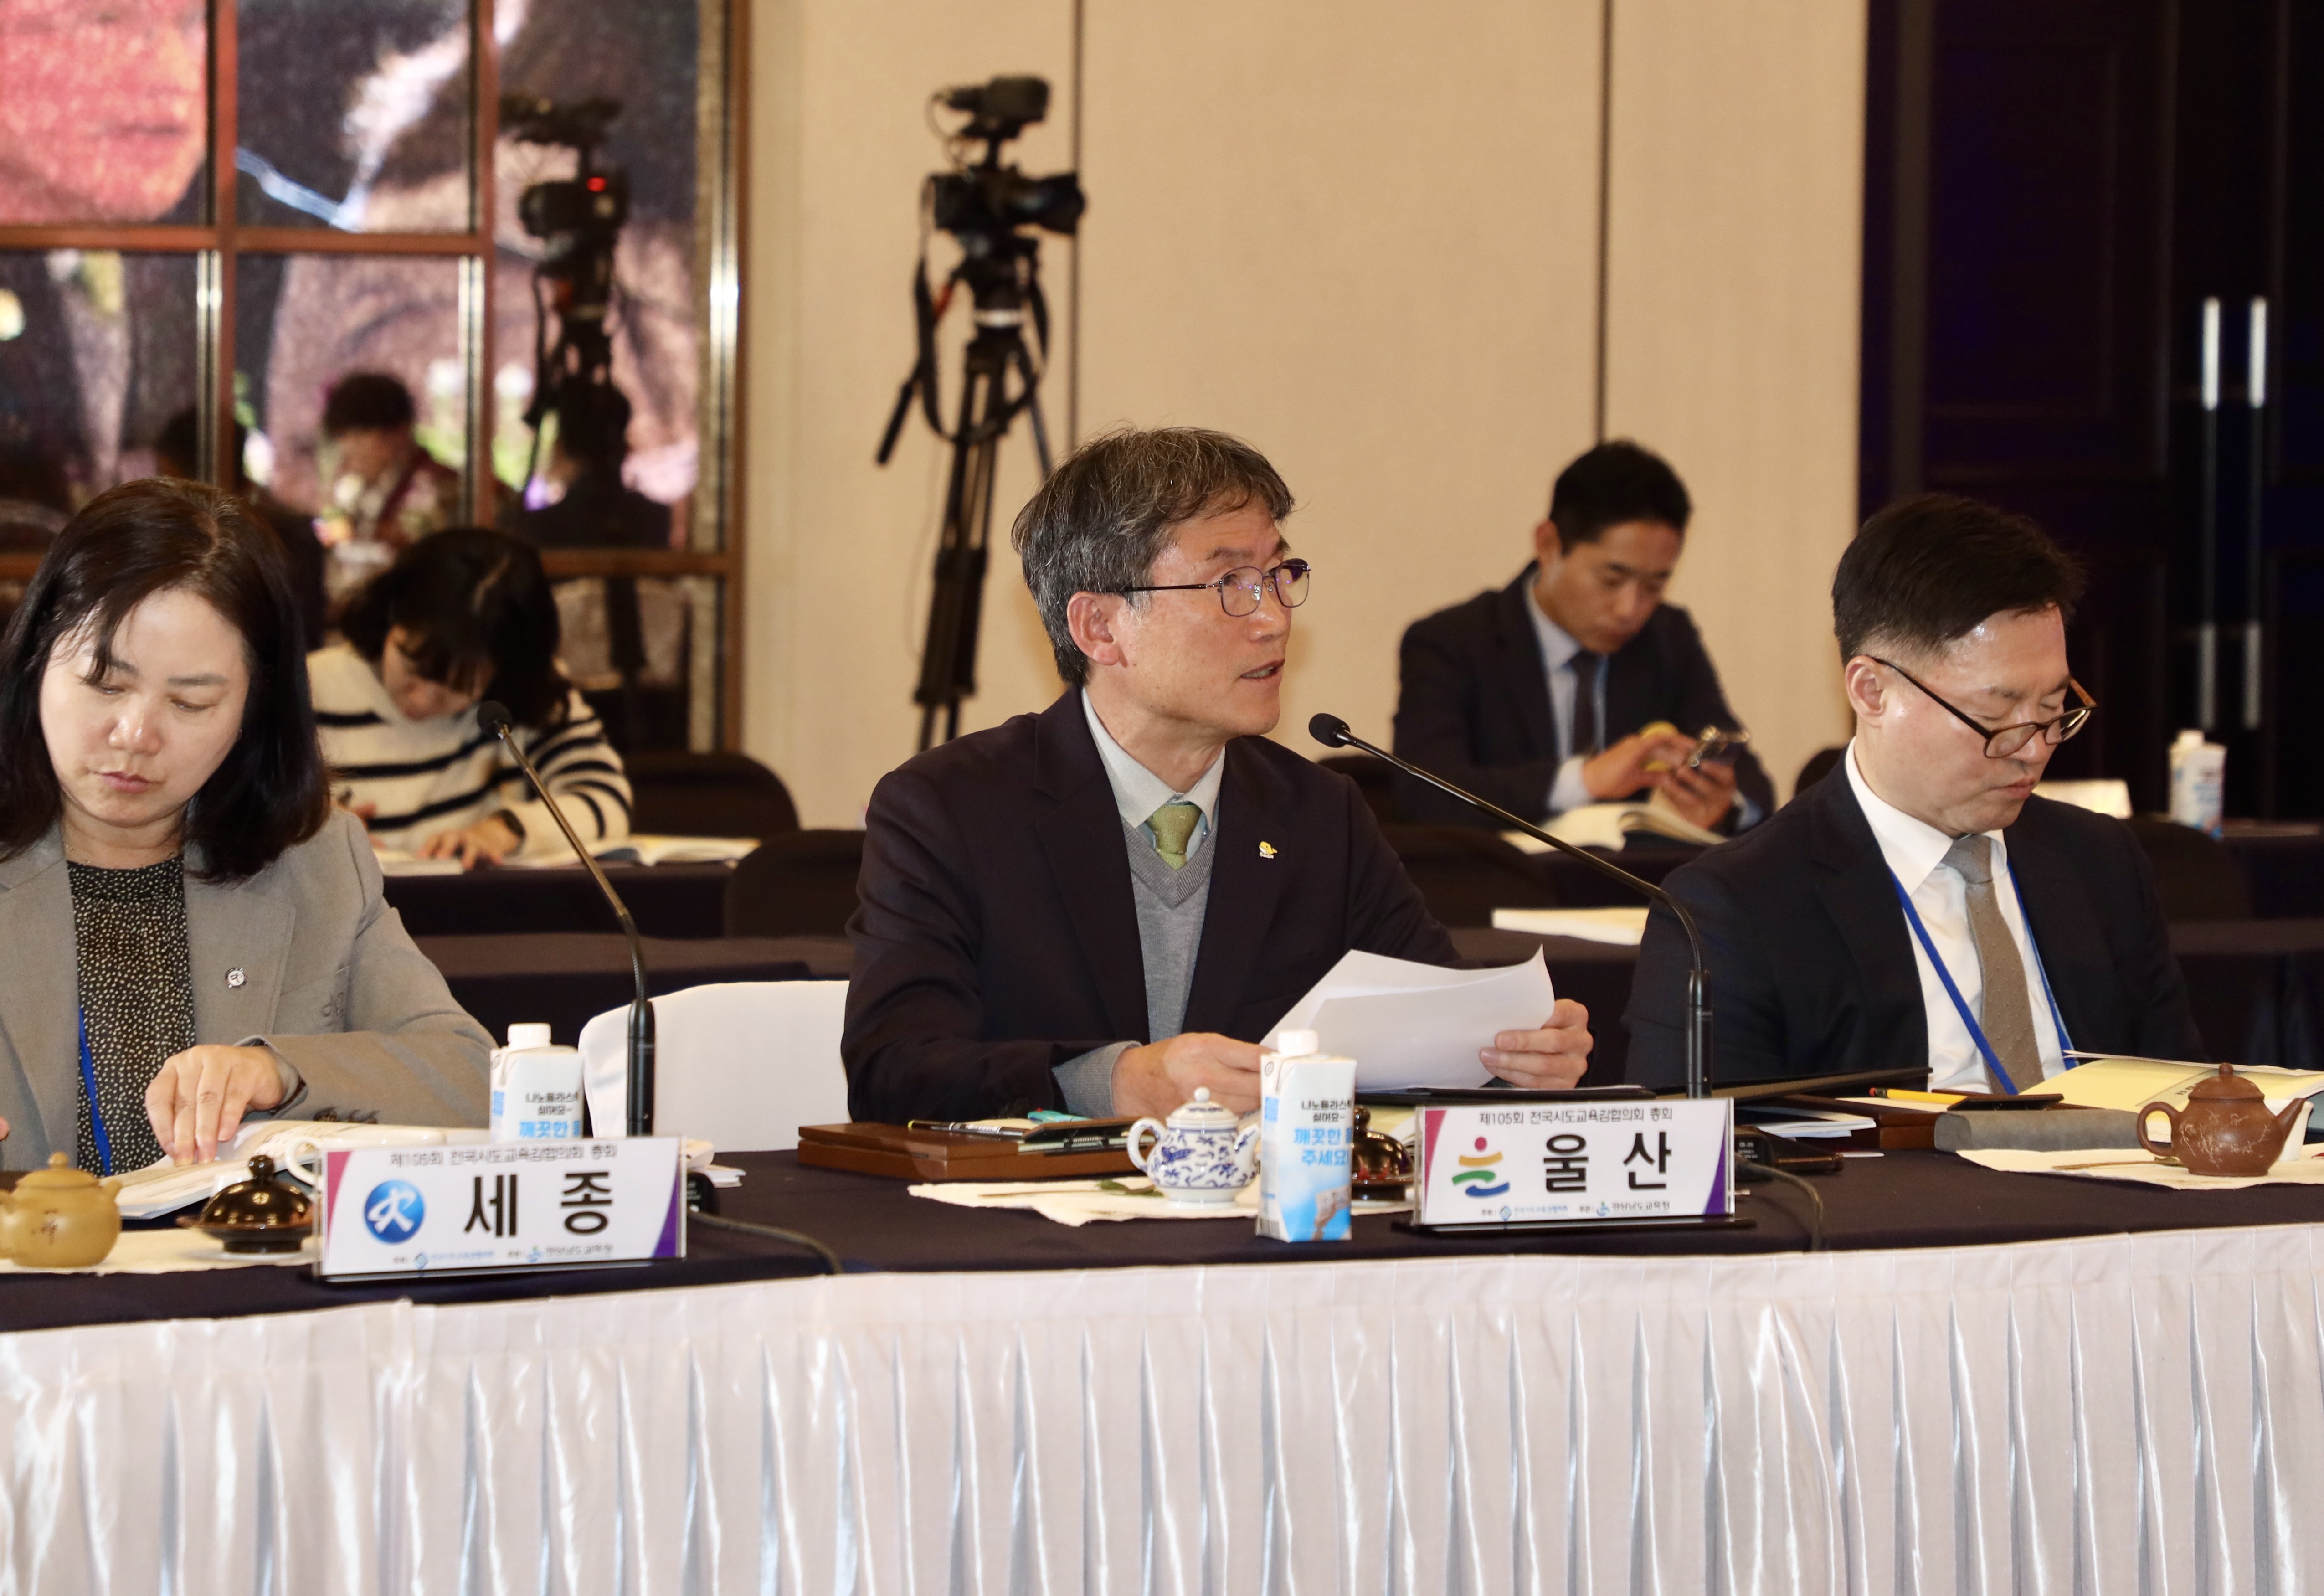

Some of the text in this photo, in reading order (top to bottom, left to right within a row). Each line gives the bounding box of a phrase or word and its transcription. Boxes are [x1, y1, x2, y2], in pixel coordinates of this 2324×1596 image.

[1479, 1107, 1673, 1126] 제105회 전국시도교육감협의회 총회
[1294, 1127, 1342, 1145] 깨끗한
[390, 1152, 444, 1168] 제105회
[591, 1143, 618, 1160] 총회
